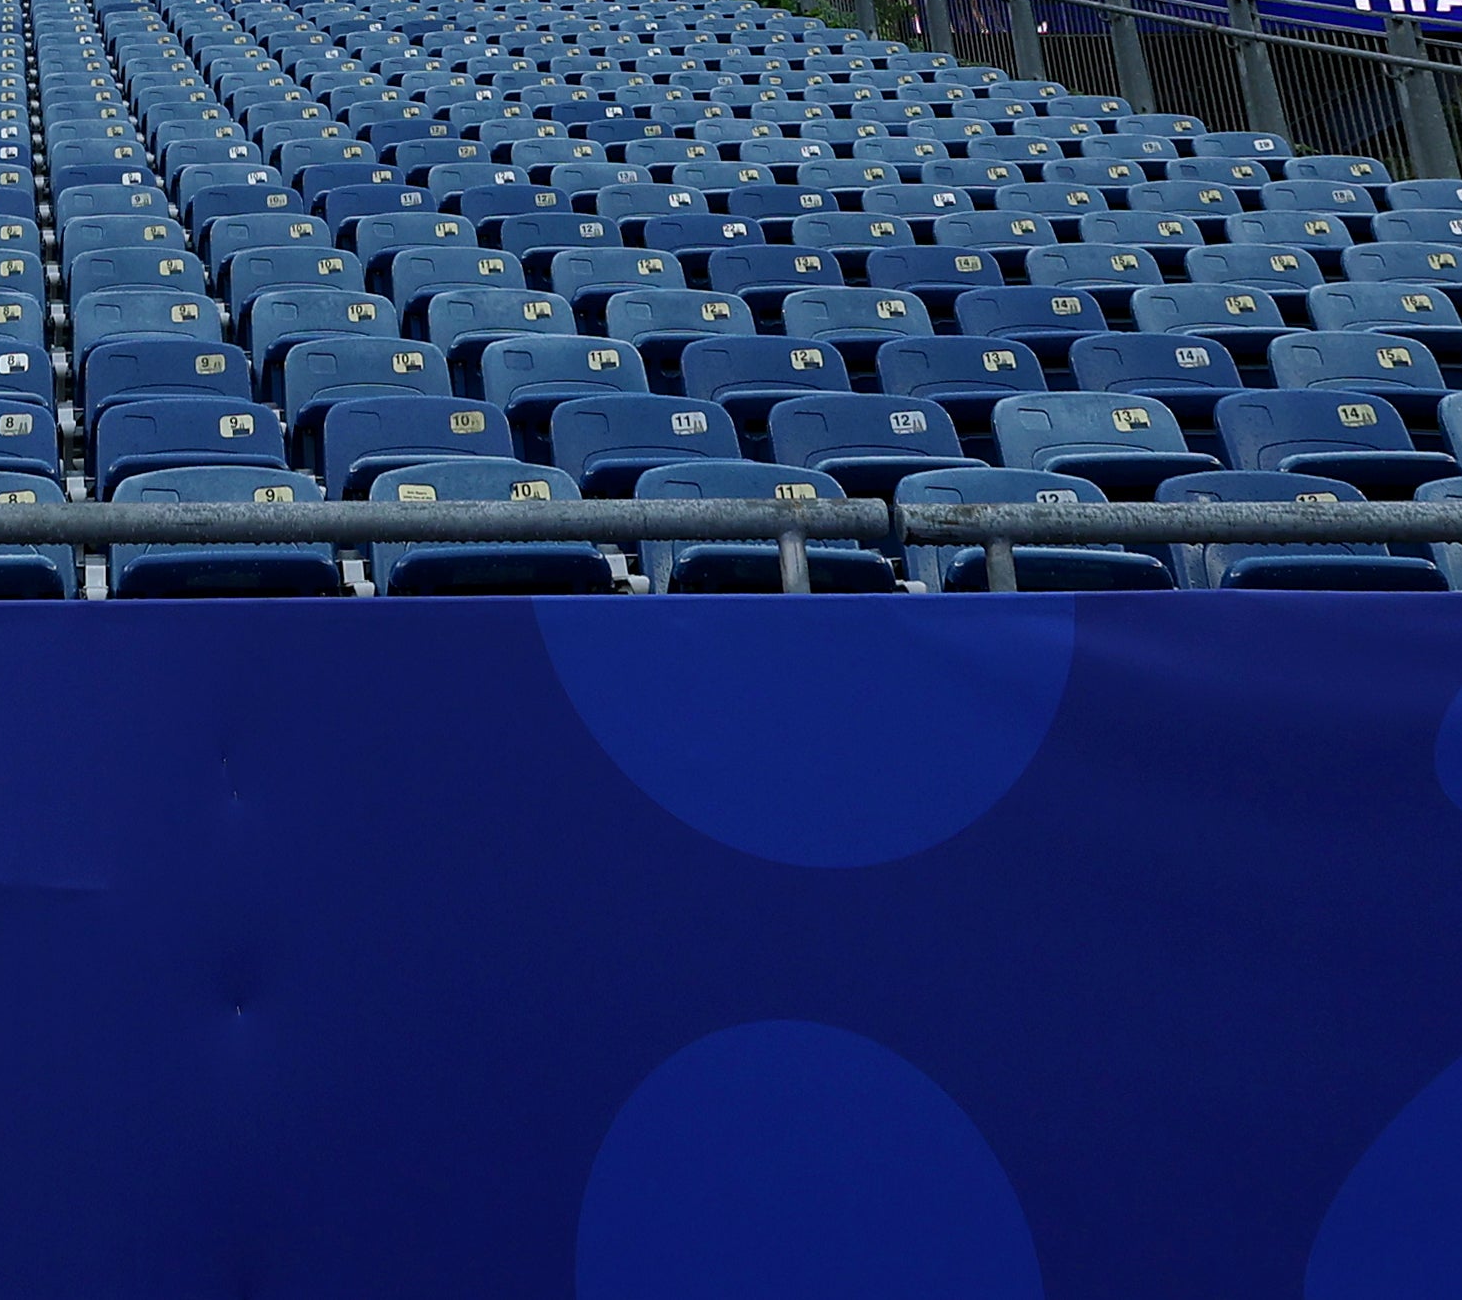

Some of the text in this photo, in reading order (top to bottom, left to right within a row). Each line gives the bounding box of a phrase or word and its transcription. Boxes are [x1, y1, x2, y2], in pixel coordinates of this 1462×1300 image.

[1116, 411, 1132, 422] 13
[1344, 409, 1359, 419] 14
[6, 417, 14, 428] 8
[230, 417, 238, 428] 9
[454, 415, 469, 426] 10
[676, 416, 690, 427] 11
[893, 415, 909, 426] 12
[266, 489, 275, 501] 9
[513, 483, 532, 496] 10
[778, 486, 792, 498] 11
[8, 494, 17, 504] 8
[1040, 494, 1058, 503] 12
